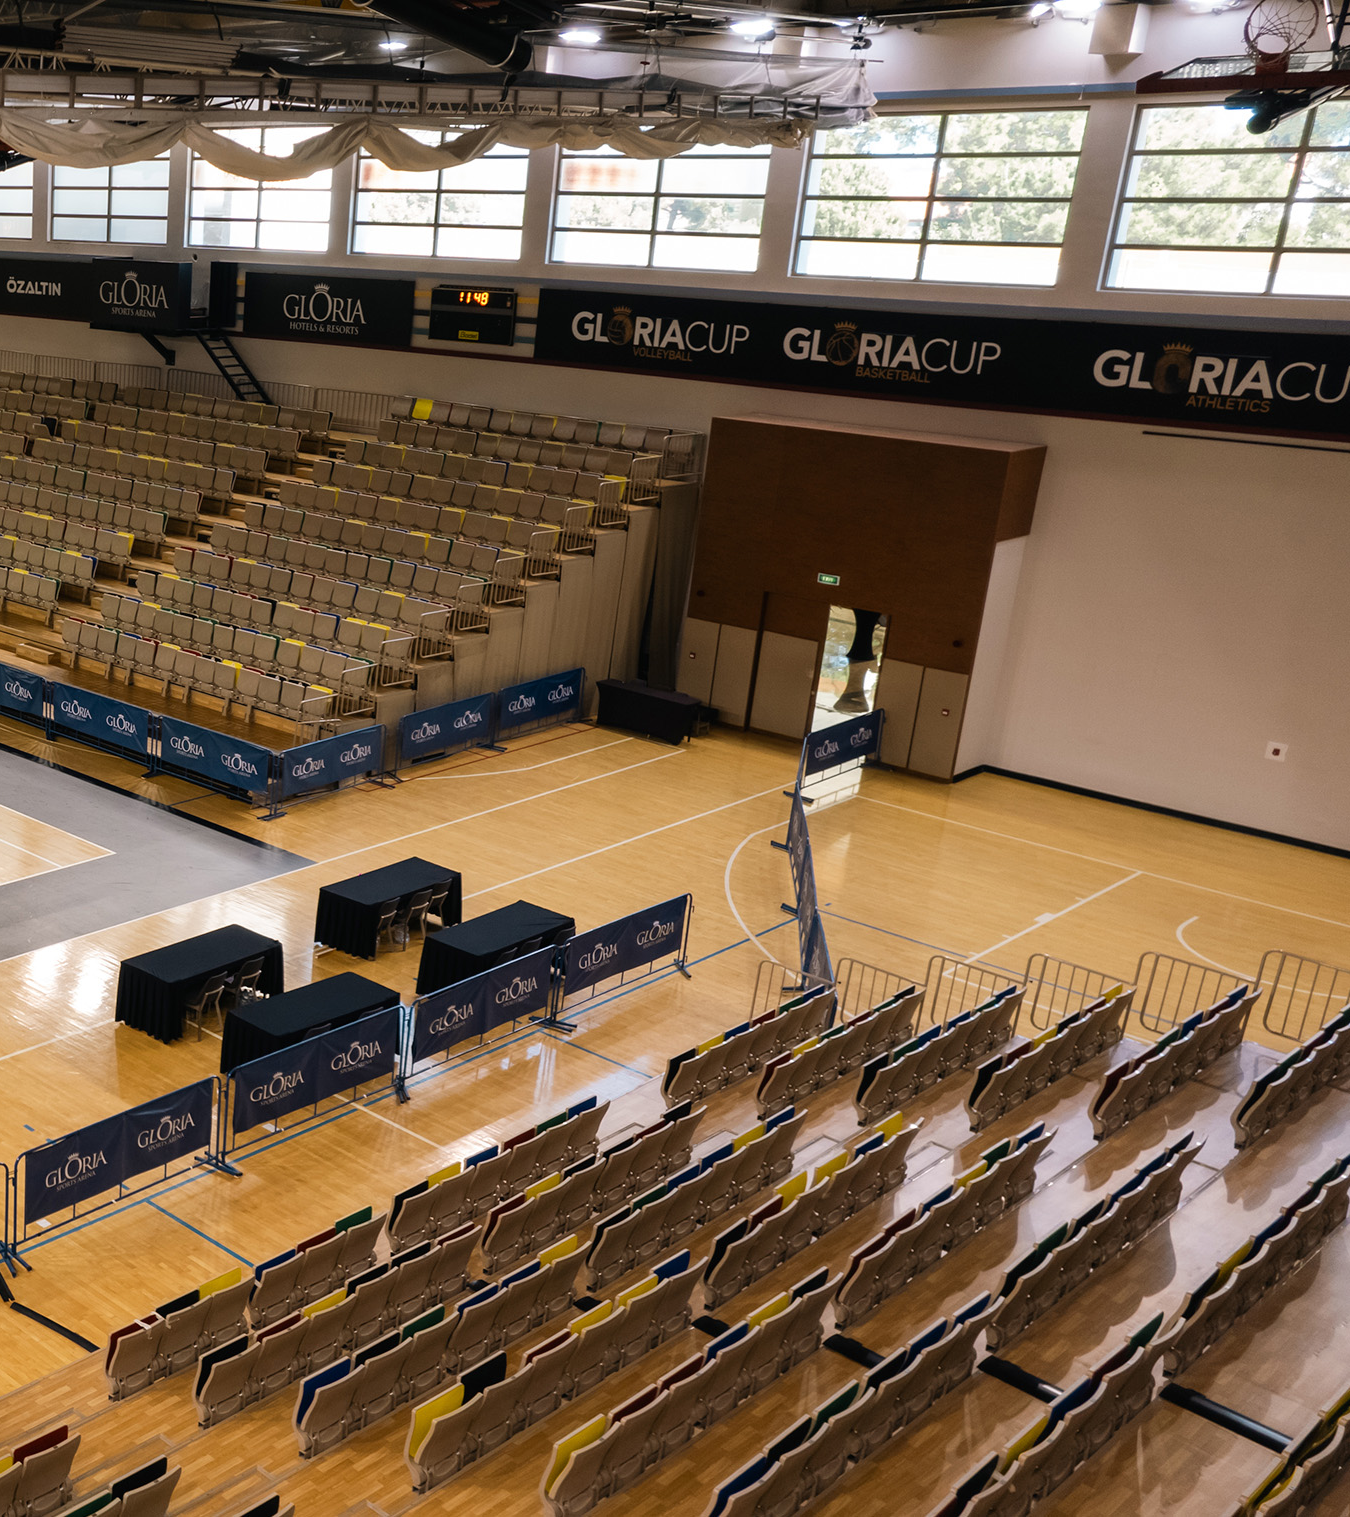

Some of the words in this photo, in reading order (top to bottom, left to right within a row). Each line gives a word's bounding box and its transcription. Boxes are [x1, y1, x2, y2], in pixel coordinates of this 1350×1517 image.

[6, 277, 61, 296] ÖZALTIN
[100, 279, 169, 309] GLORIA
[111, 306, 134, 316] SPORTS
[135, 309, 156, 318] ARENA
[283, 291, 367, 324] GLORIA
[289, 322, 317, 332] HOTELS
[327, 324, 359, 335] RESORTS
[632, 346, 693, 362] VOLLEYBALL
[855, 366, 931, 384] BASKETBALL
[1093, 349, 1350, 404] GLORIACU
[1185, 395, 1271, 413] ATHLETICS
[548, 686, 573, 701] GLORIA
[61, 700, 92, 720] GLORIA
[509, 696, 536, 712] GLORIA
[106, 715, 137, 735] GLORIA
[454, 712, 482, 728] GLORIA
[411, 723, 440, 740] GLORIA
[170, 737, 204, 757] GLORIA
[340, 745, 371, 763] GLORIA
[221, 754, 258, 775] GLORIA
[293, 759, 325, 776] GLORIA
[636, 921, 674, 946] GLORIA
[579, 943, 618, 970] GLORIA
[495, 976, 538, 1004] GLORIA
[430, 1003, 474, 1034] GLORIA
[331, 1040, 382, 1072] GLORIA
[250, 1070, 304, 1104] GLORIA
[137, 1112, 195, 1150] GLORIA
[45, 1150, 108, 1190] GLORIA
[56, 1179, 76, 1192] SPORTS
[77, 1170, 97, 1185] ARENA
